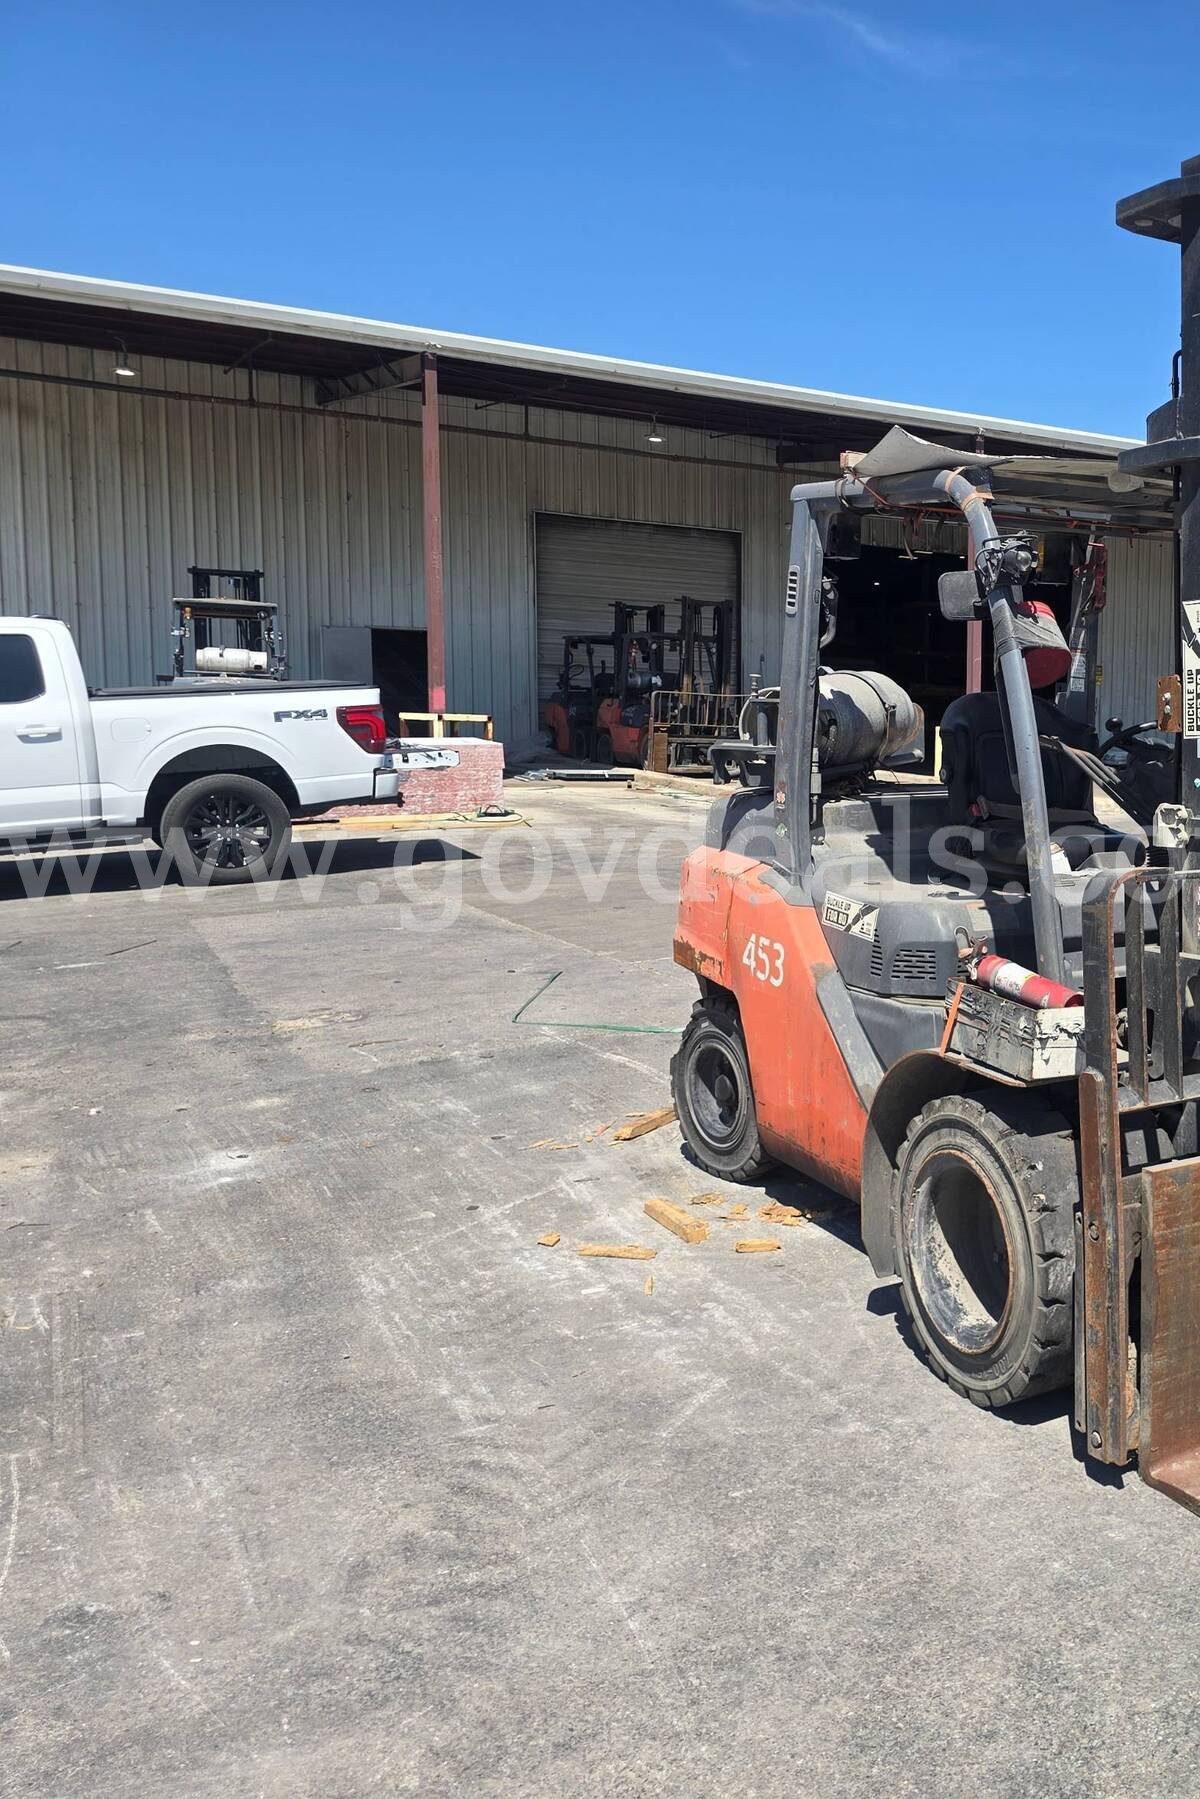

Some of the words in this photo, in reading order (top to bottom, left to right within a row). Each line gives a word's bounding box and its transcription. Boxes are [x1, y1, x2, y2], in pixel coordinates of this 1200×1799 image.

[1187, 669, 1195, 683] UP
[273, 708, 328, 722] FX4
[1187, 687, 1195, 732] BUCKLE
[742, 933, 784, 987] 453
